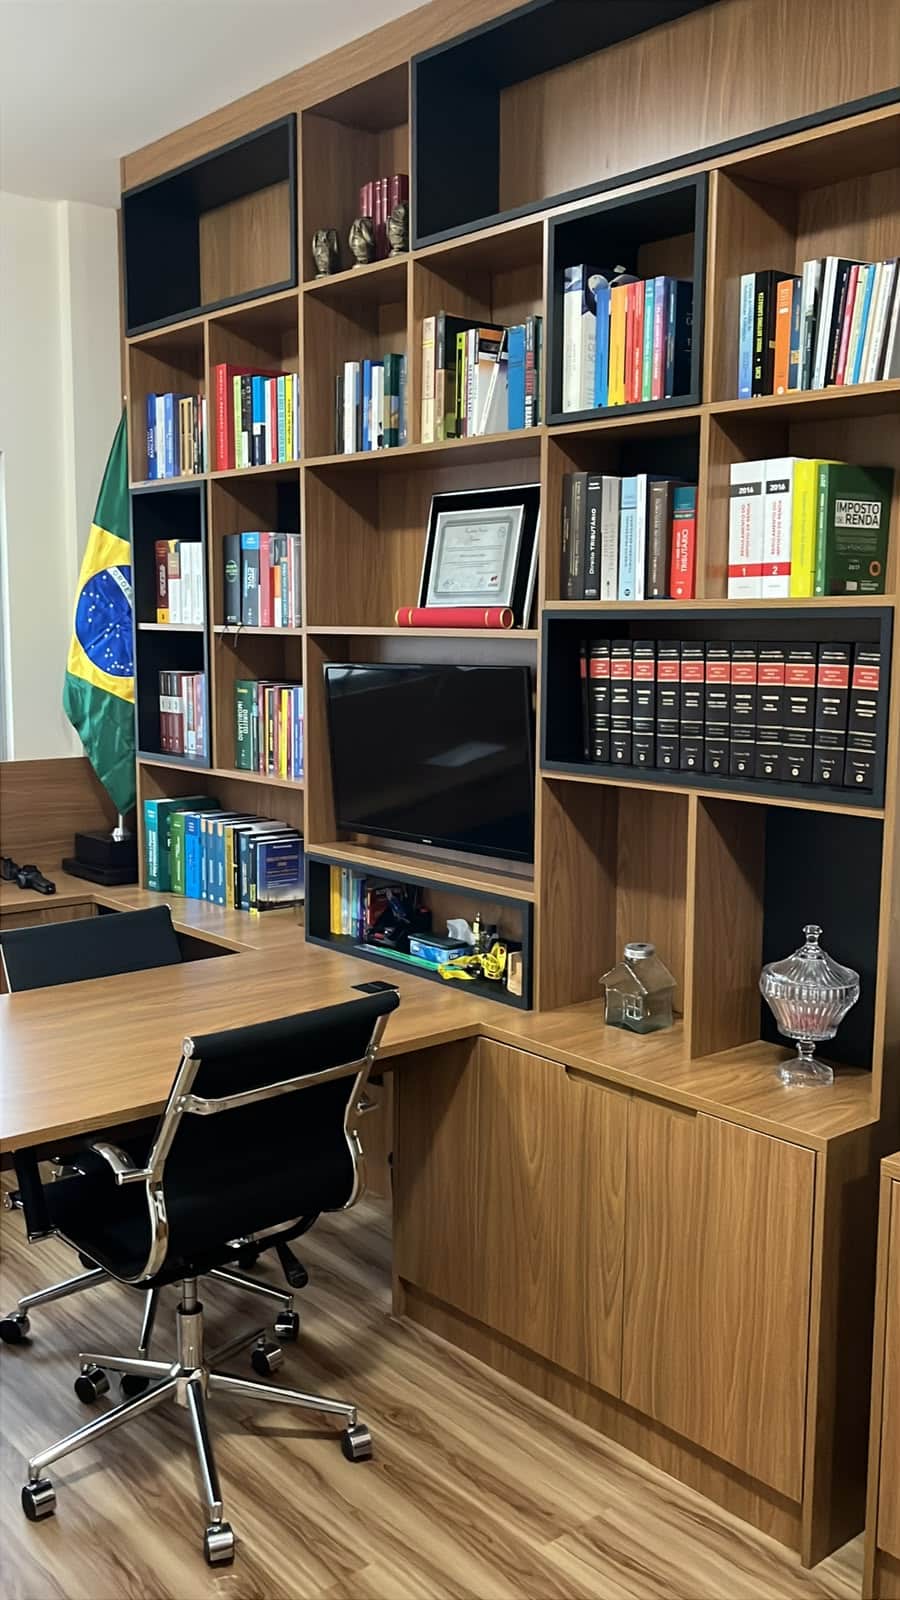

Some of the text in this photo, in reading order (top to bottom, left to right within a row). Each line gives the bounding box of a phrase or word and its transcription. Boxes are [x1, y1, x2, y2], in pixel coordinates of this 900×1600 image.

[738, 486, 754, 494] 2016
[769, 482, 786, 491] 2016
[836, 502, 880, 514] IMPOSTO
[845, 514, 879, 526] RENDA
[680, 529, 689, 572] TRIBUTÁRIO
[742, 567, 747, 576] 1
[771, 566, 778, 575] 2
